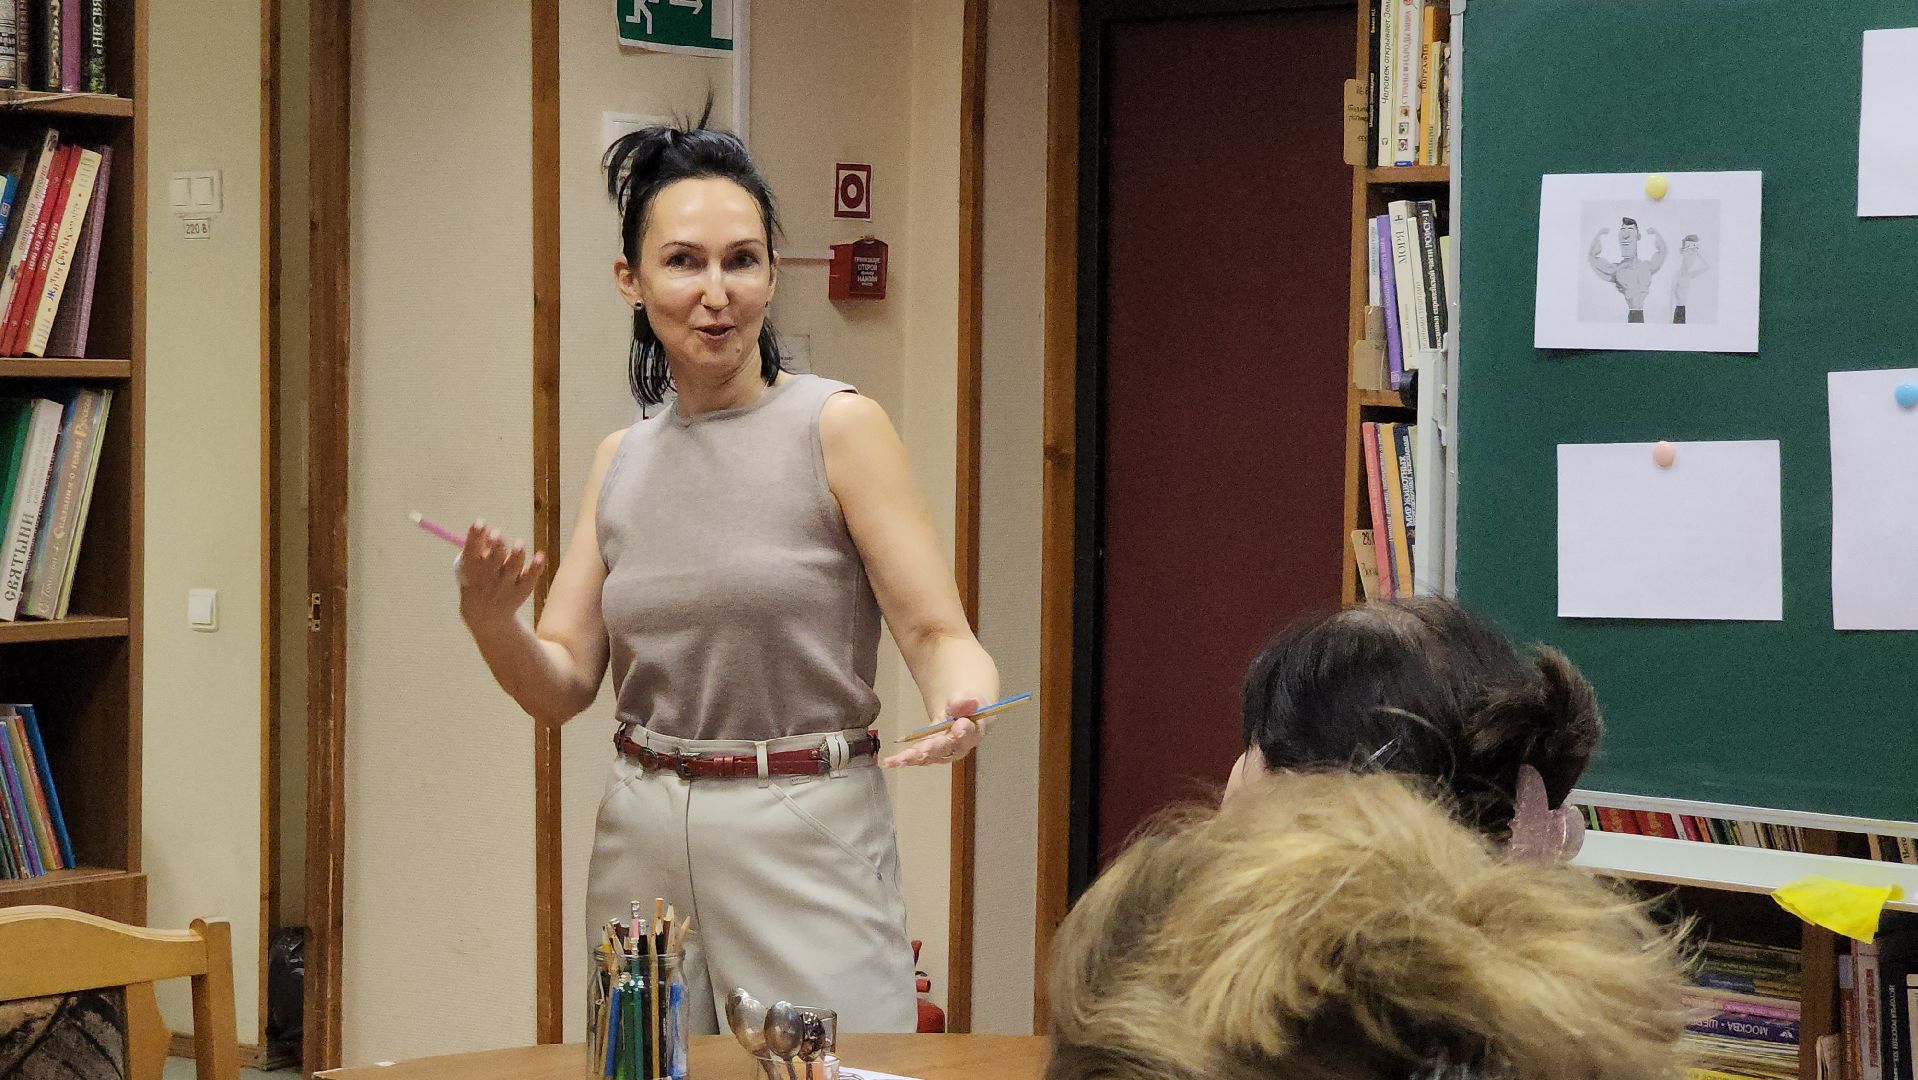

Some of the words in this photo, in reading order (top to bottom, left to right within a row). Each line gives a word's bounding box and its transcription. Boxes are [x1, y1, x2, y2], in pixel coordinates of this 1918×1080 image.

[1384, 19, 1393, 64] открывает
[1381, 65, 1390, 104] Человек
[186, 223, 199, 235] 220
[1393, 231, 1407, 264] МОРЯ
[1399, 455, 1410, 505] ЖИВОТНЫХ
[1404, 506, 1414, 527] МИР
[5, 513, 35, 602] СВЯТЫНИ
[1727, 1020, 1768, 1036] МОСКВА
